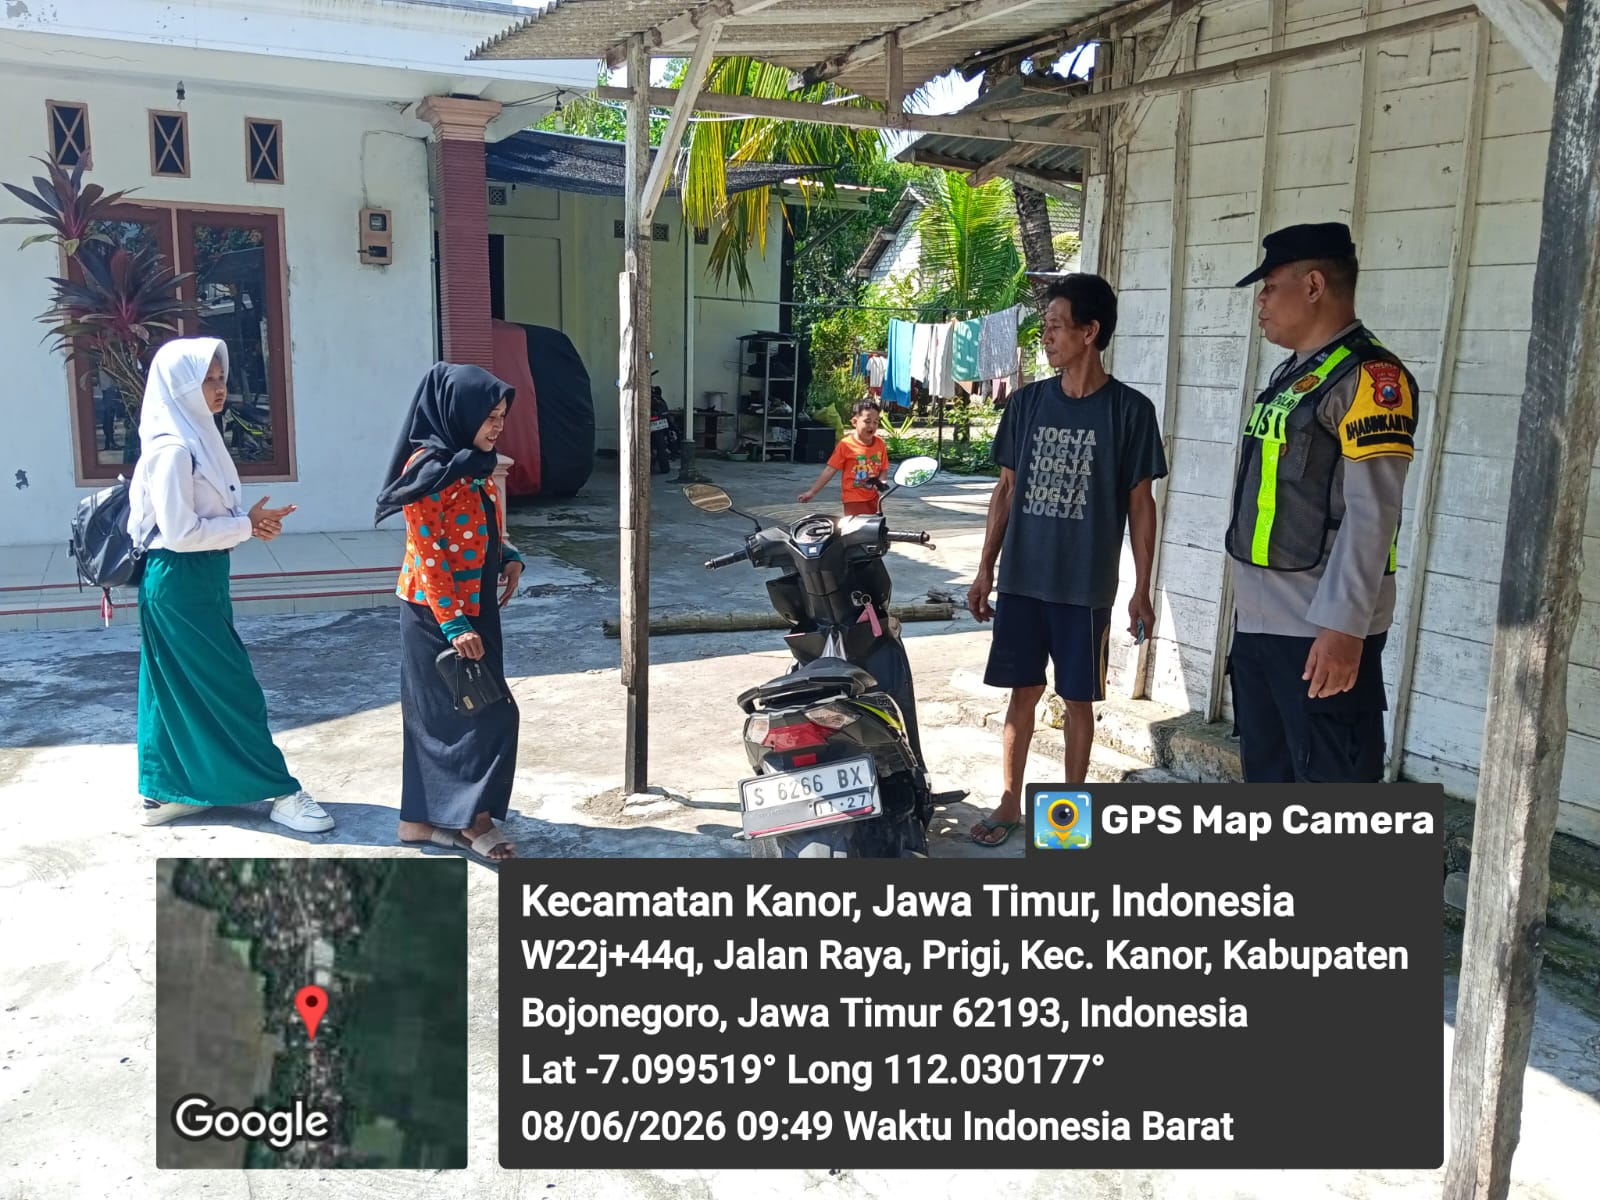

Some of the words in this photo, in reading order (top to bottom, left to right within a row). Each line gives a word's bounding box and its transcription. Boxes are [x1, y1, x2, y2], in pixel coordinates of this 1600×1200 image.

[1033, 427, 1096, 446] JOGJA
[1031, 441, 1094, 461] JOGJA
[1029, 456, 1091, 476] JOGJA
[1027, 471, 1089, 490] JOGJA
[1025, 485, 1087, 505] JOGJA
[1022, 499, 1084, 520] JOGJA
[754, 788, 765, 806] S
[777, 774, 823, 801] 6266
[837, 766, 863, 789] BX
